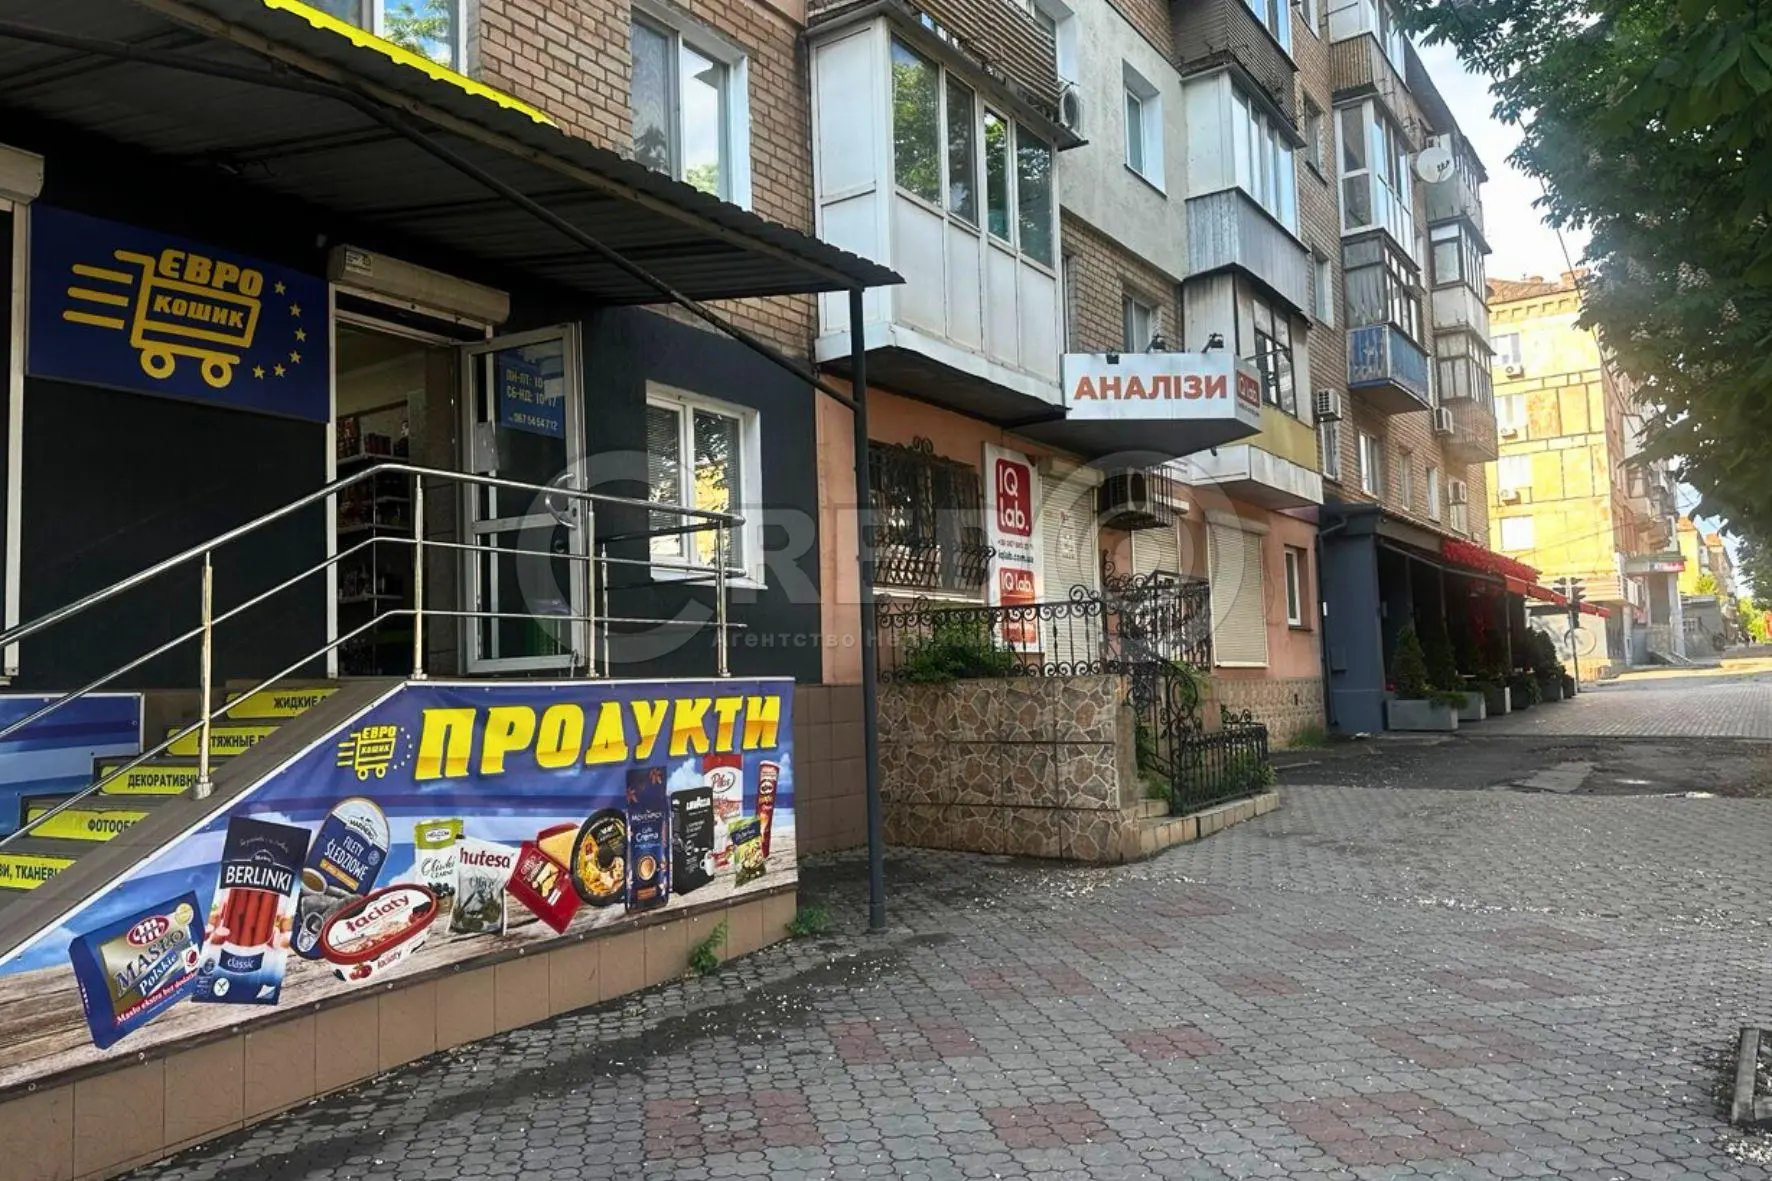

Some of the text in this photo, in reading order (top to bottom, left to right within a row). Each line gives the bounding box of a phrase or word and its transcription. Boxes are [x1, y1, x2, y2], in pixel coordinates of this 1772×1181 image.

[153, 294, 244, 329] КОШИК
[1073, 374, 1228, 400] АНАЛІЗИ
[998, 464, 1019, 498] IQ
[999, 497, 1030, 532] lab.
[1001, 571, 1014, 591] IQ
[273, 695, 318, 709] ЖИДКИЕ
[198, 734, 256, 748] ТЯЖНЫЕ
[414, 695, 781, 781] ПРОДУКТИ
[87, 819, 136, 833] ФОТООБ
[459, 847, 511, 869] hutesa
[225, 865, 292, 891] BERLINKI
[139, 953, 178, 997] Polskie
